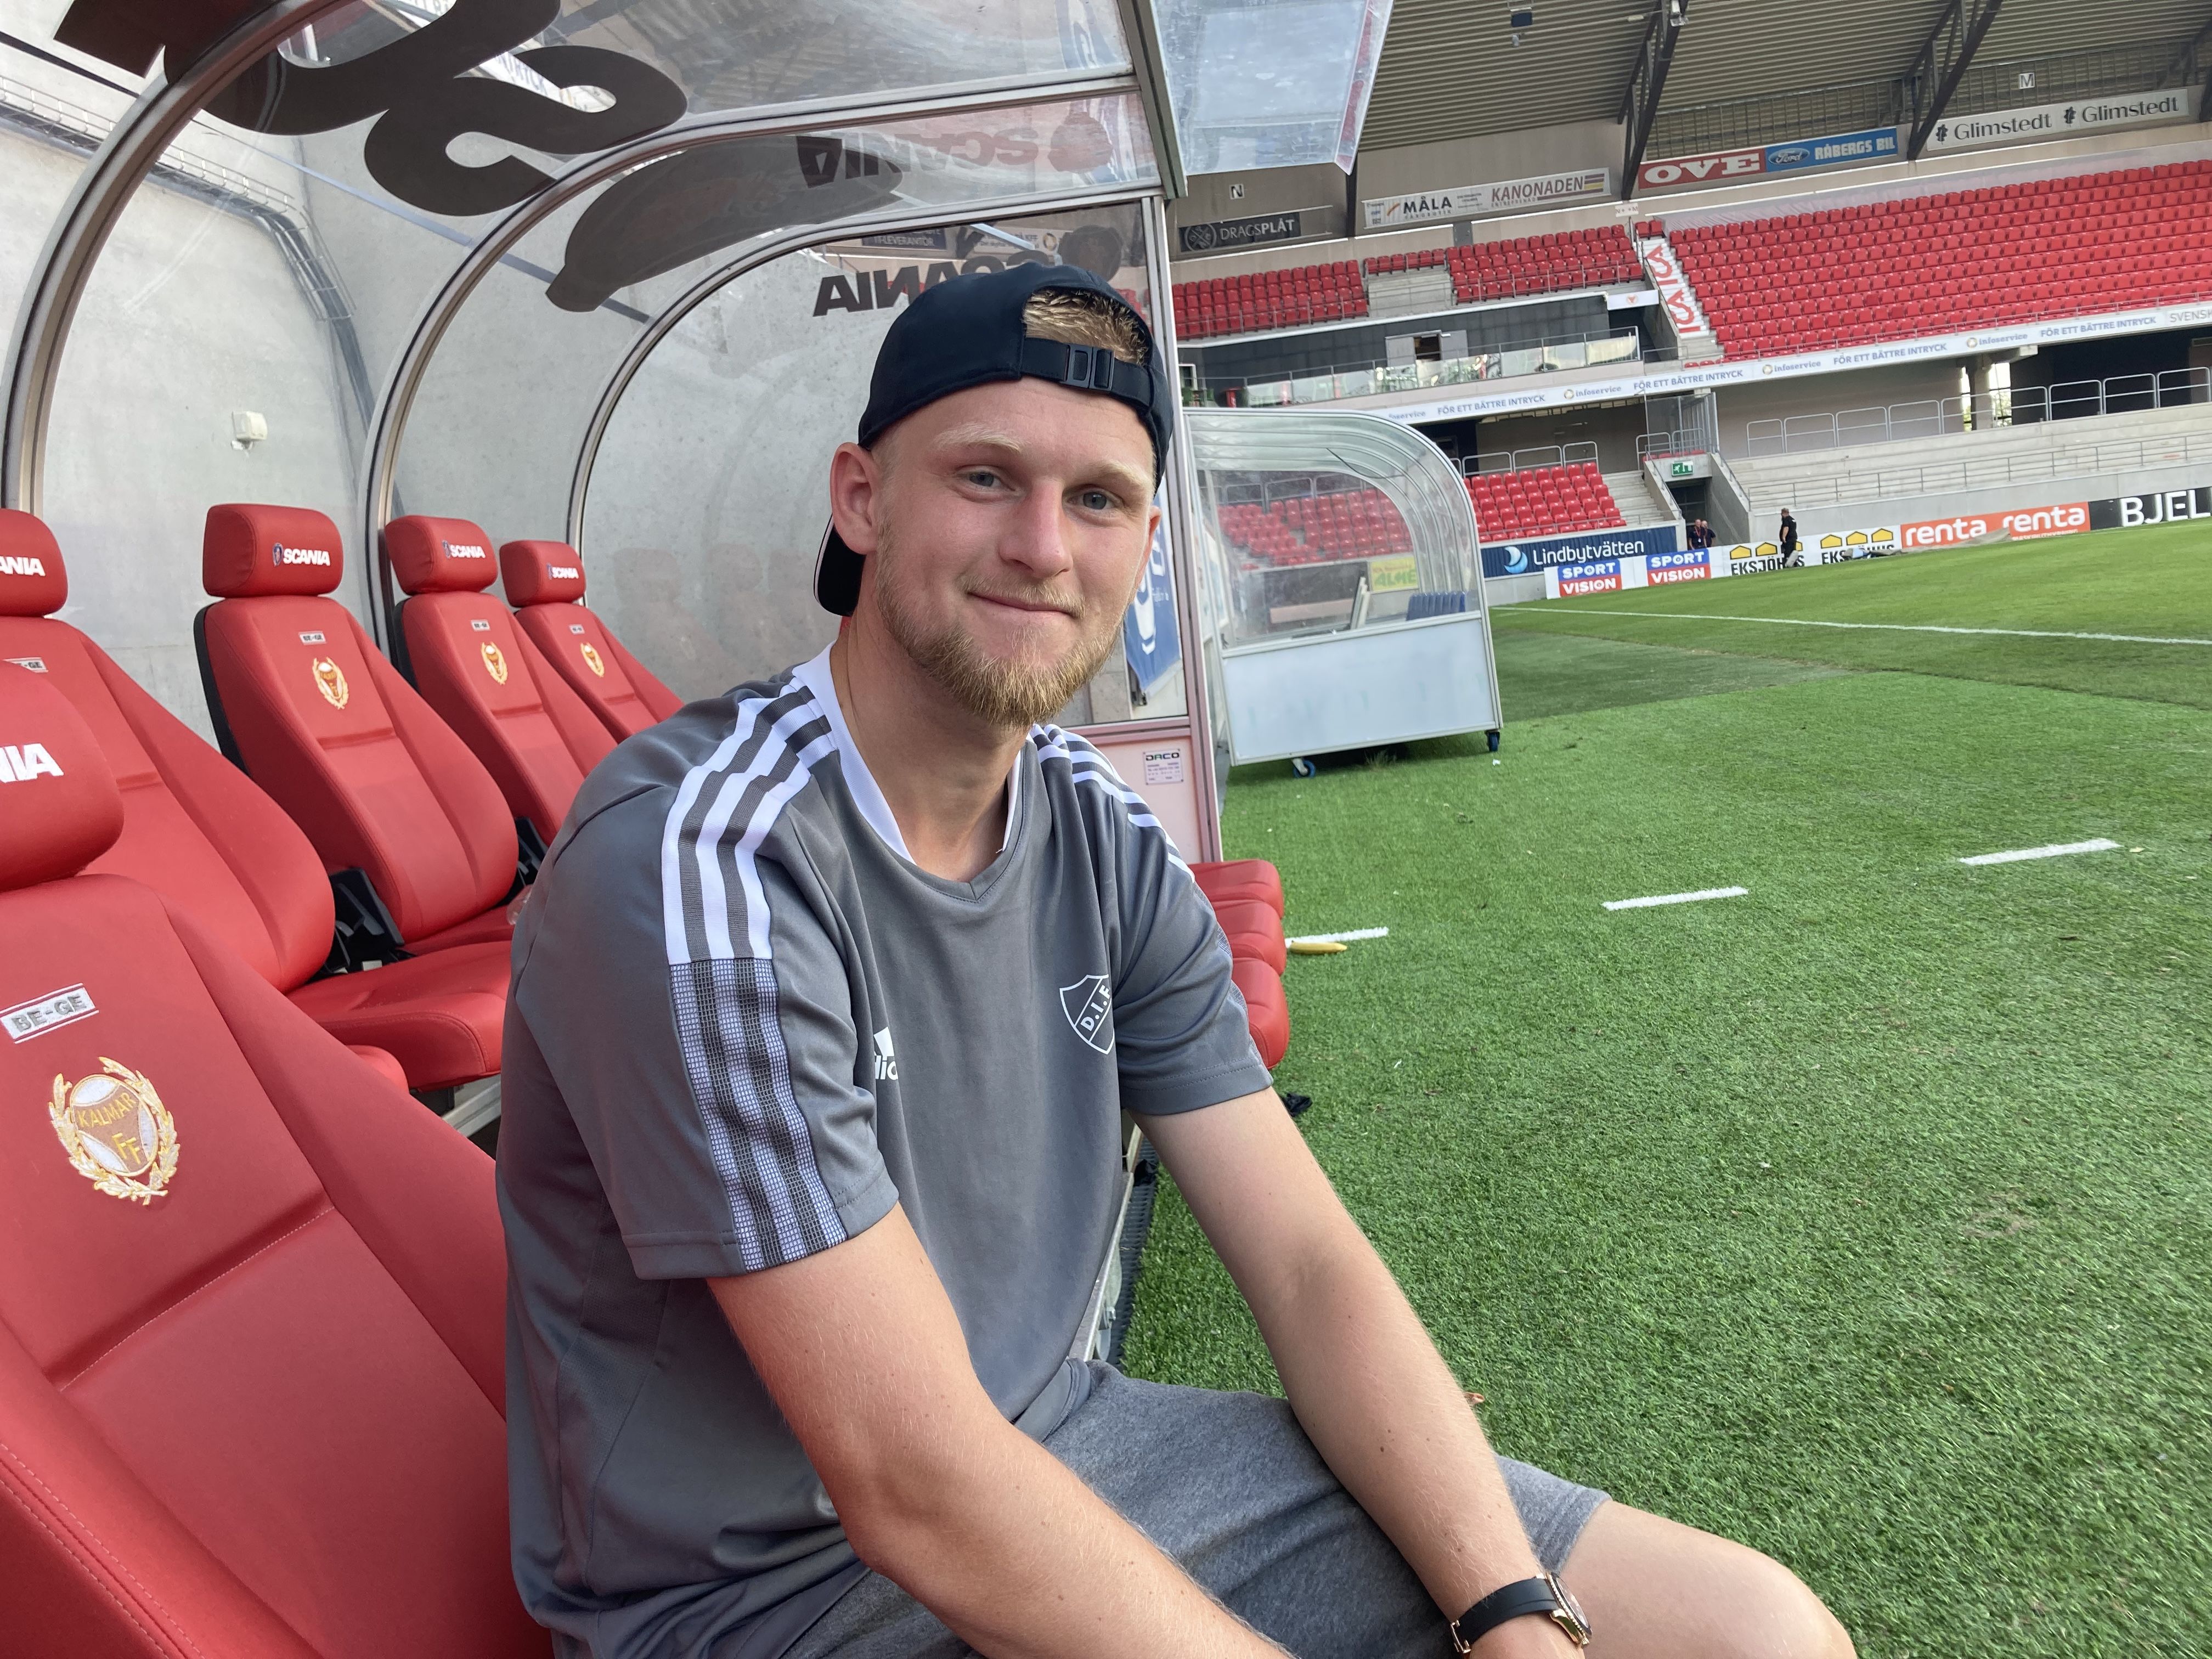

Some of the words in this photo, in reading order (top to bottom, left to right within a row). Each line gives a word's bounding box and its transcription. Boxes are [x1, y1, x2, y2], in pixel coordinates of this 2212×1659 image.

[2020, 75, 2034, 87] M
[2082, 97, 2179, 123] Glimstedt
[1954, 113, 2052, 140] Glimstedt
[1775, 151, 1805, 164] Ford
[1815, 138, 1873, 160] RÅBERGS
[1876, 136, 1895, 151] BIL
[1644, 153, 1760, 183] OVE
[1231, 185, 1243, 198] N
[1492, 176, 1584, 202] KANONADEN
[1402, 195, 1453, 214] MÅLA
[1220, 217, 1295, 240] DRAGSPLÅT
[2041, 326, 2059, 338] FÖR
[2062, 325, 2078, 335] ETT
[2080, 321, 2115, 333] BÄTTRE
[2117, 316, 2157, 329] INTRYCK
[1979, 332, 2028, 346] infoservice
[1833, 353, 1850, 365] FÖR
[1853, 352, 1869, 362] ETT
[1872, 348, 1905, 360] BÄTTRE
[1907, 342, 1948, 356] INTRYCK
[1774, 360, 1821, 373] infoservice
[1634, 380, 1651, 390] FÖR
[1654, 377, 1669, 387] ETT
[1671, 374, 1704, 386] BÄTTRE
[1706, 369, 1743, 382] INTRYCK
[1576, 385, 1622, 398] infoservice
[1437, 405, 1455, 415] FÖR
[1457, 403, 1472, 414] ETT
[1474, 399, 1506, 411] BÄTTRE
[1509, 394, 1546, 408] INTRYCK
[2002, 505, 2085, 532] renta
[2120, 489, 2211, 527] BJEL
[1905, 517, 1988, 547] renta
[283, 549, 330, 566] SCANIA
[450, 544, 486, 559] SCANIA
[1533, 540, 1645, 566] Lindbytvätten
[1651, 551, 1705, 567] SPORT
[552, 567, 579, 579] SCANIA
[1562, 562, 1616, 579] SPORT
[1651, 567, 1705, 583] VISION
[1731, 555, 1805, 576] EKSJÖHS
[1562, 578, 1616, 594] VISION
[1146, 752, 1181, 761] DACO
[11, 994, 87, 1032] BE-GE
[76, 1092, 137, 1128] KALMAR
[112, 1132, 141, 1165] FF
